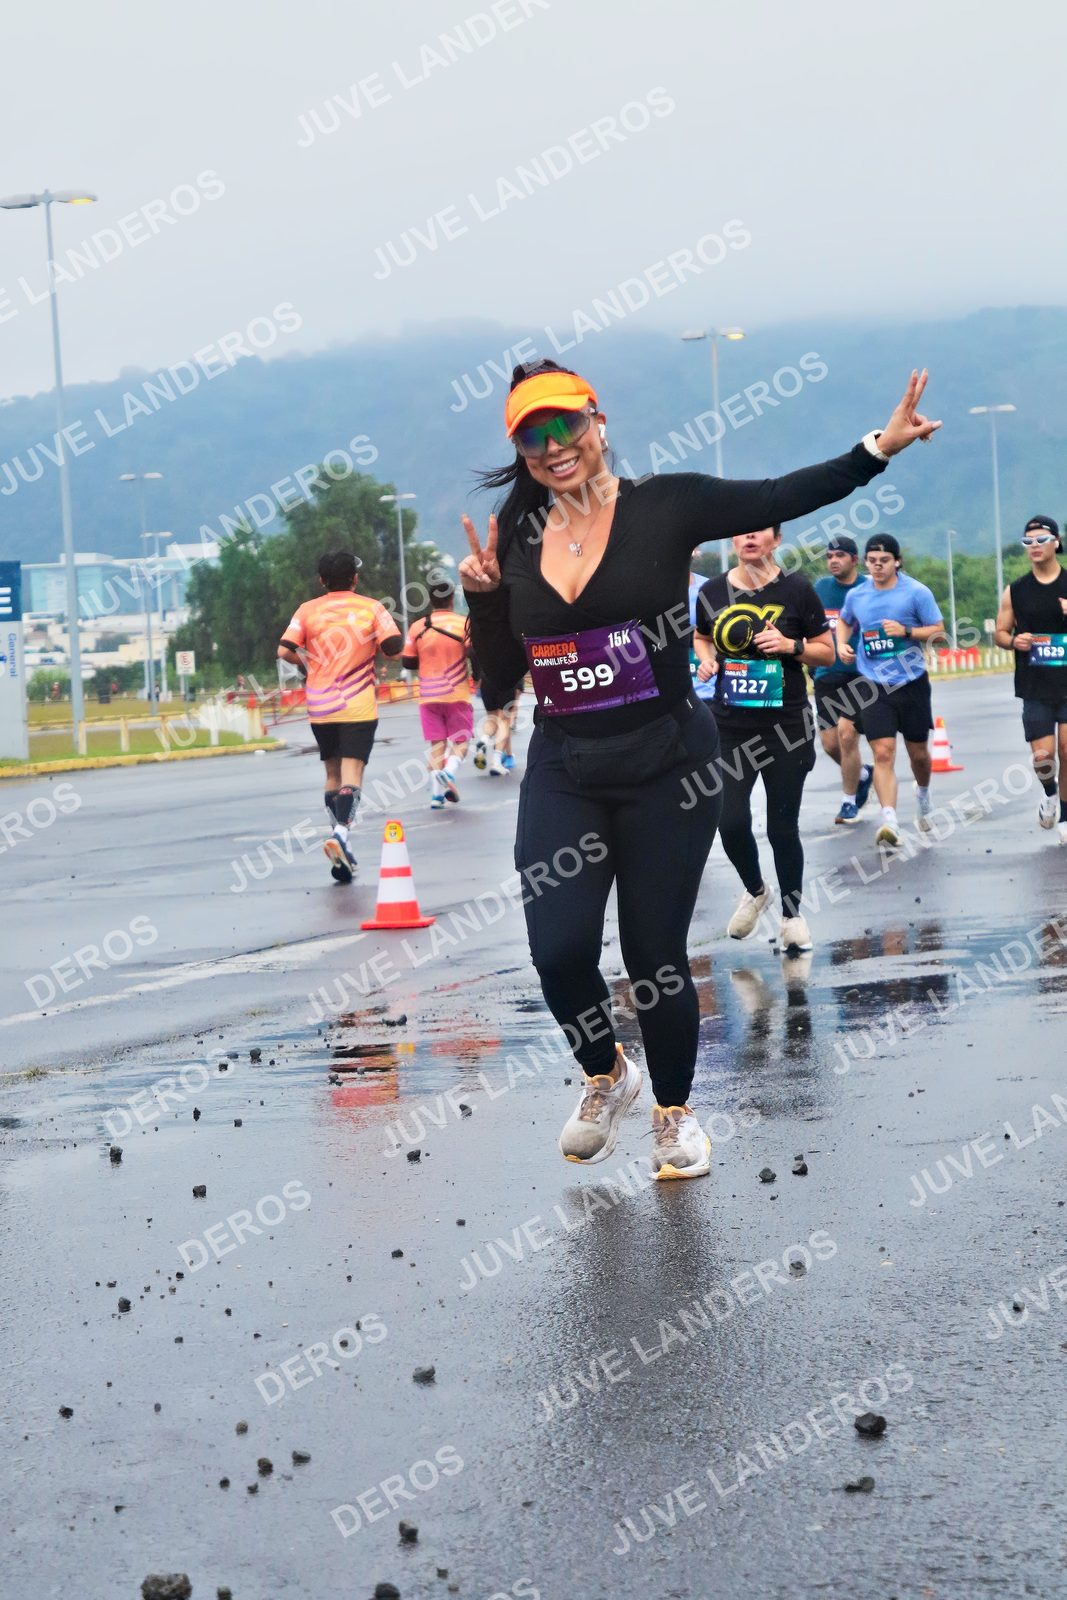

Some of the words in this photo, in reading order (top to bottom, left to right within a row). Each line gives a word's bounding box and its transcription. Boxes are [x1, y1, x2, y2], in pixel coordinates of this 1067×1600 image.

[608, 628, 631, 648] 15K
[869, 639, 894, 651] 1676
[532, 641, 577, 657] CARRERA
[1037, 646, 1065, 657] 1629
[560, 664, 614, 692] 599
[730, 679, 768, 694] 1227
